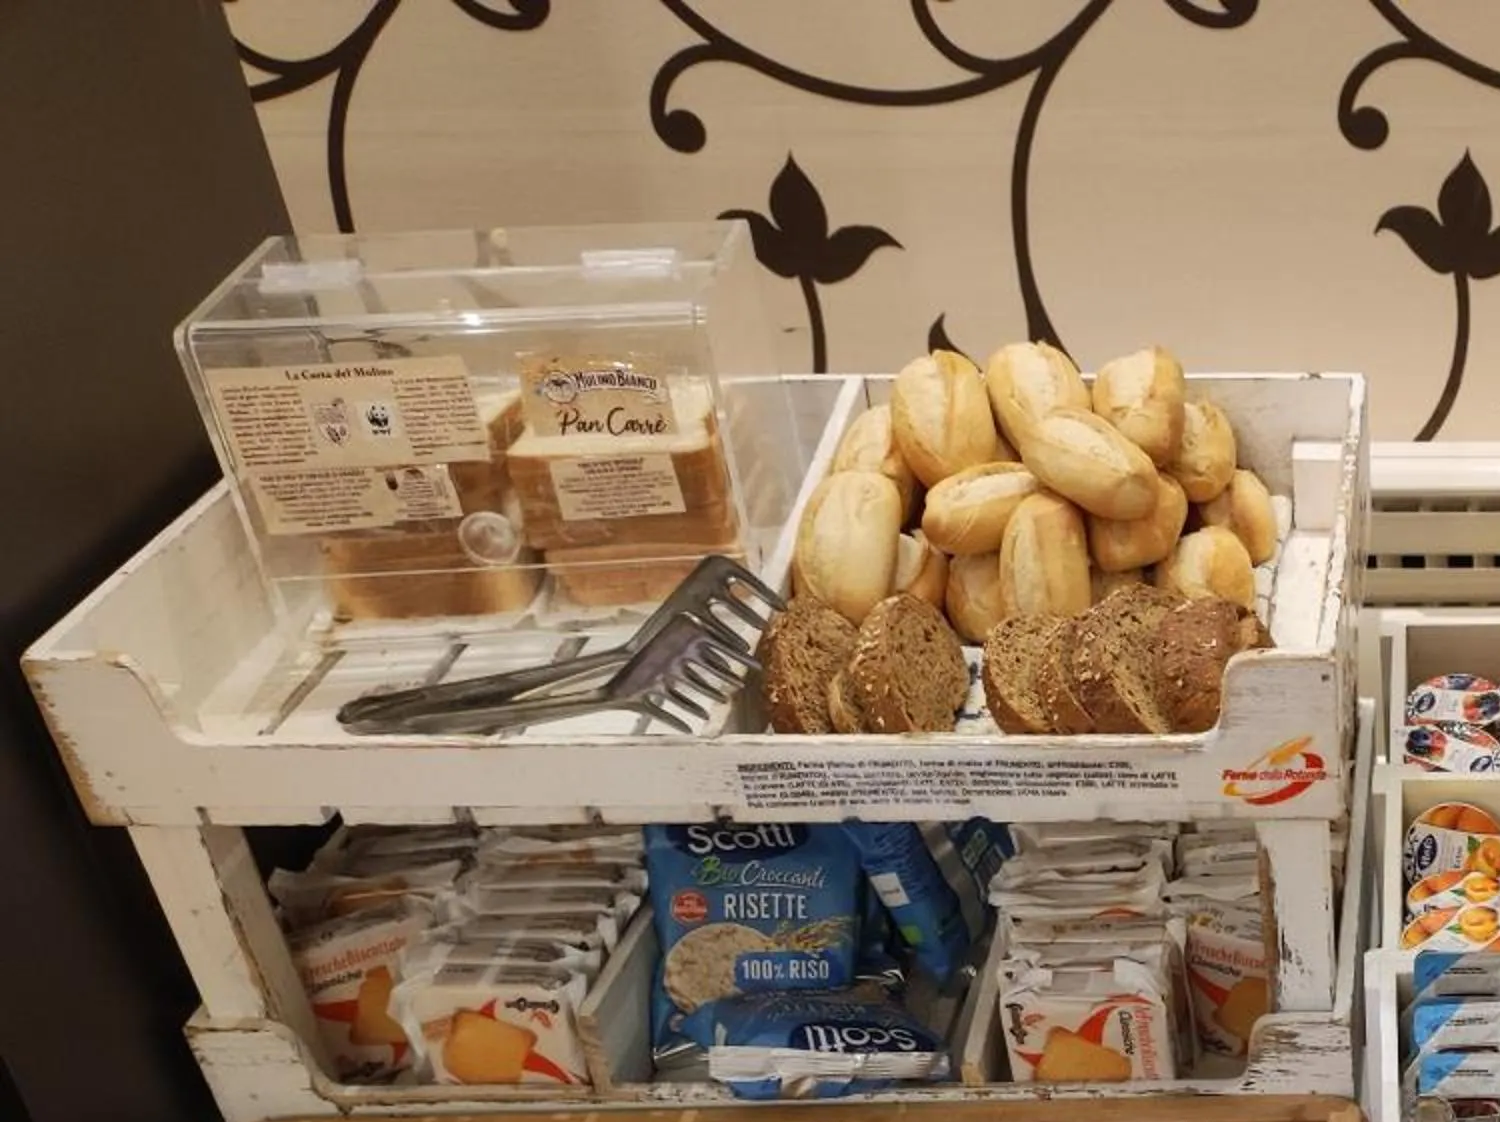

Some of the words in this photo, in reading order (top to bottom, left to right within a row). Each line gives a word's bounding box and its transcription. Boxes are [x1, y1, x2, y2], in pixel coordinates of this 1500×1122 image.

[556, 407, 604, 436] Pan
[687, 823, 796, 854] Scotti
[723, 893, 808, 920] RISETTE
[741, 959, 782, 981] 100%
[788, 958, 829, 980] RISO
